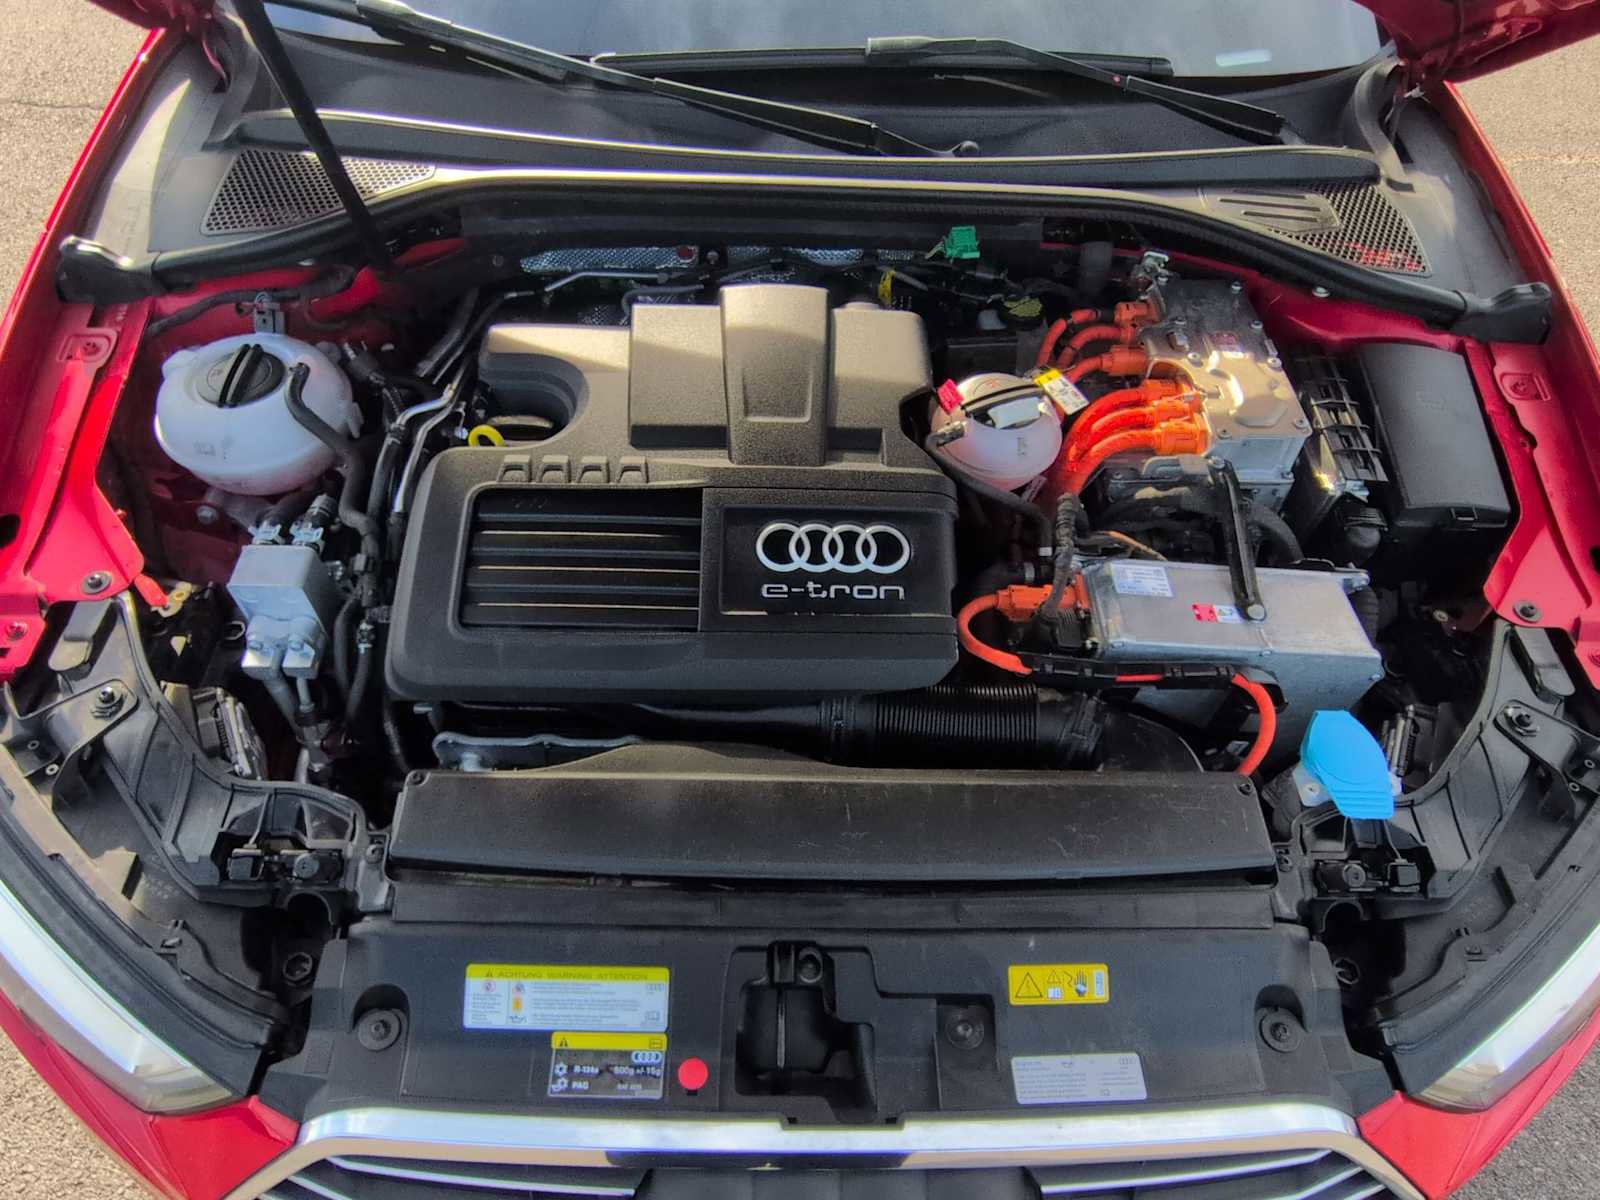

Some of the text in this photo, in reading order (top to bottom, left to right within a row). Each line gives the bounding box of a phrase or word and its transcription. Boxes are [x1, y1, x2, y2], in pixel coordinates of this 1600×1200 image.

[761, 581, 905, 600] e-tron
[497, 971, 648, 981] ACHTUNG WARNING ATTENTION
